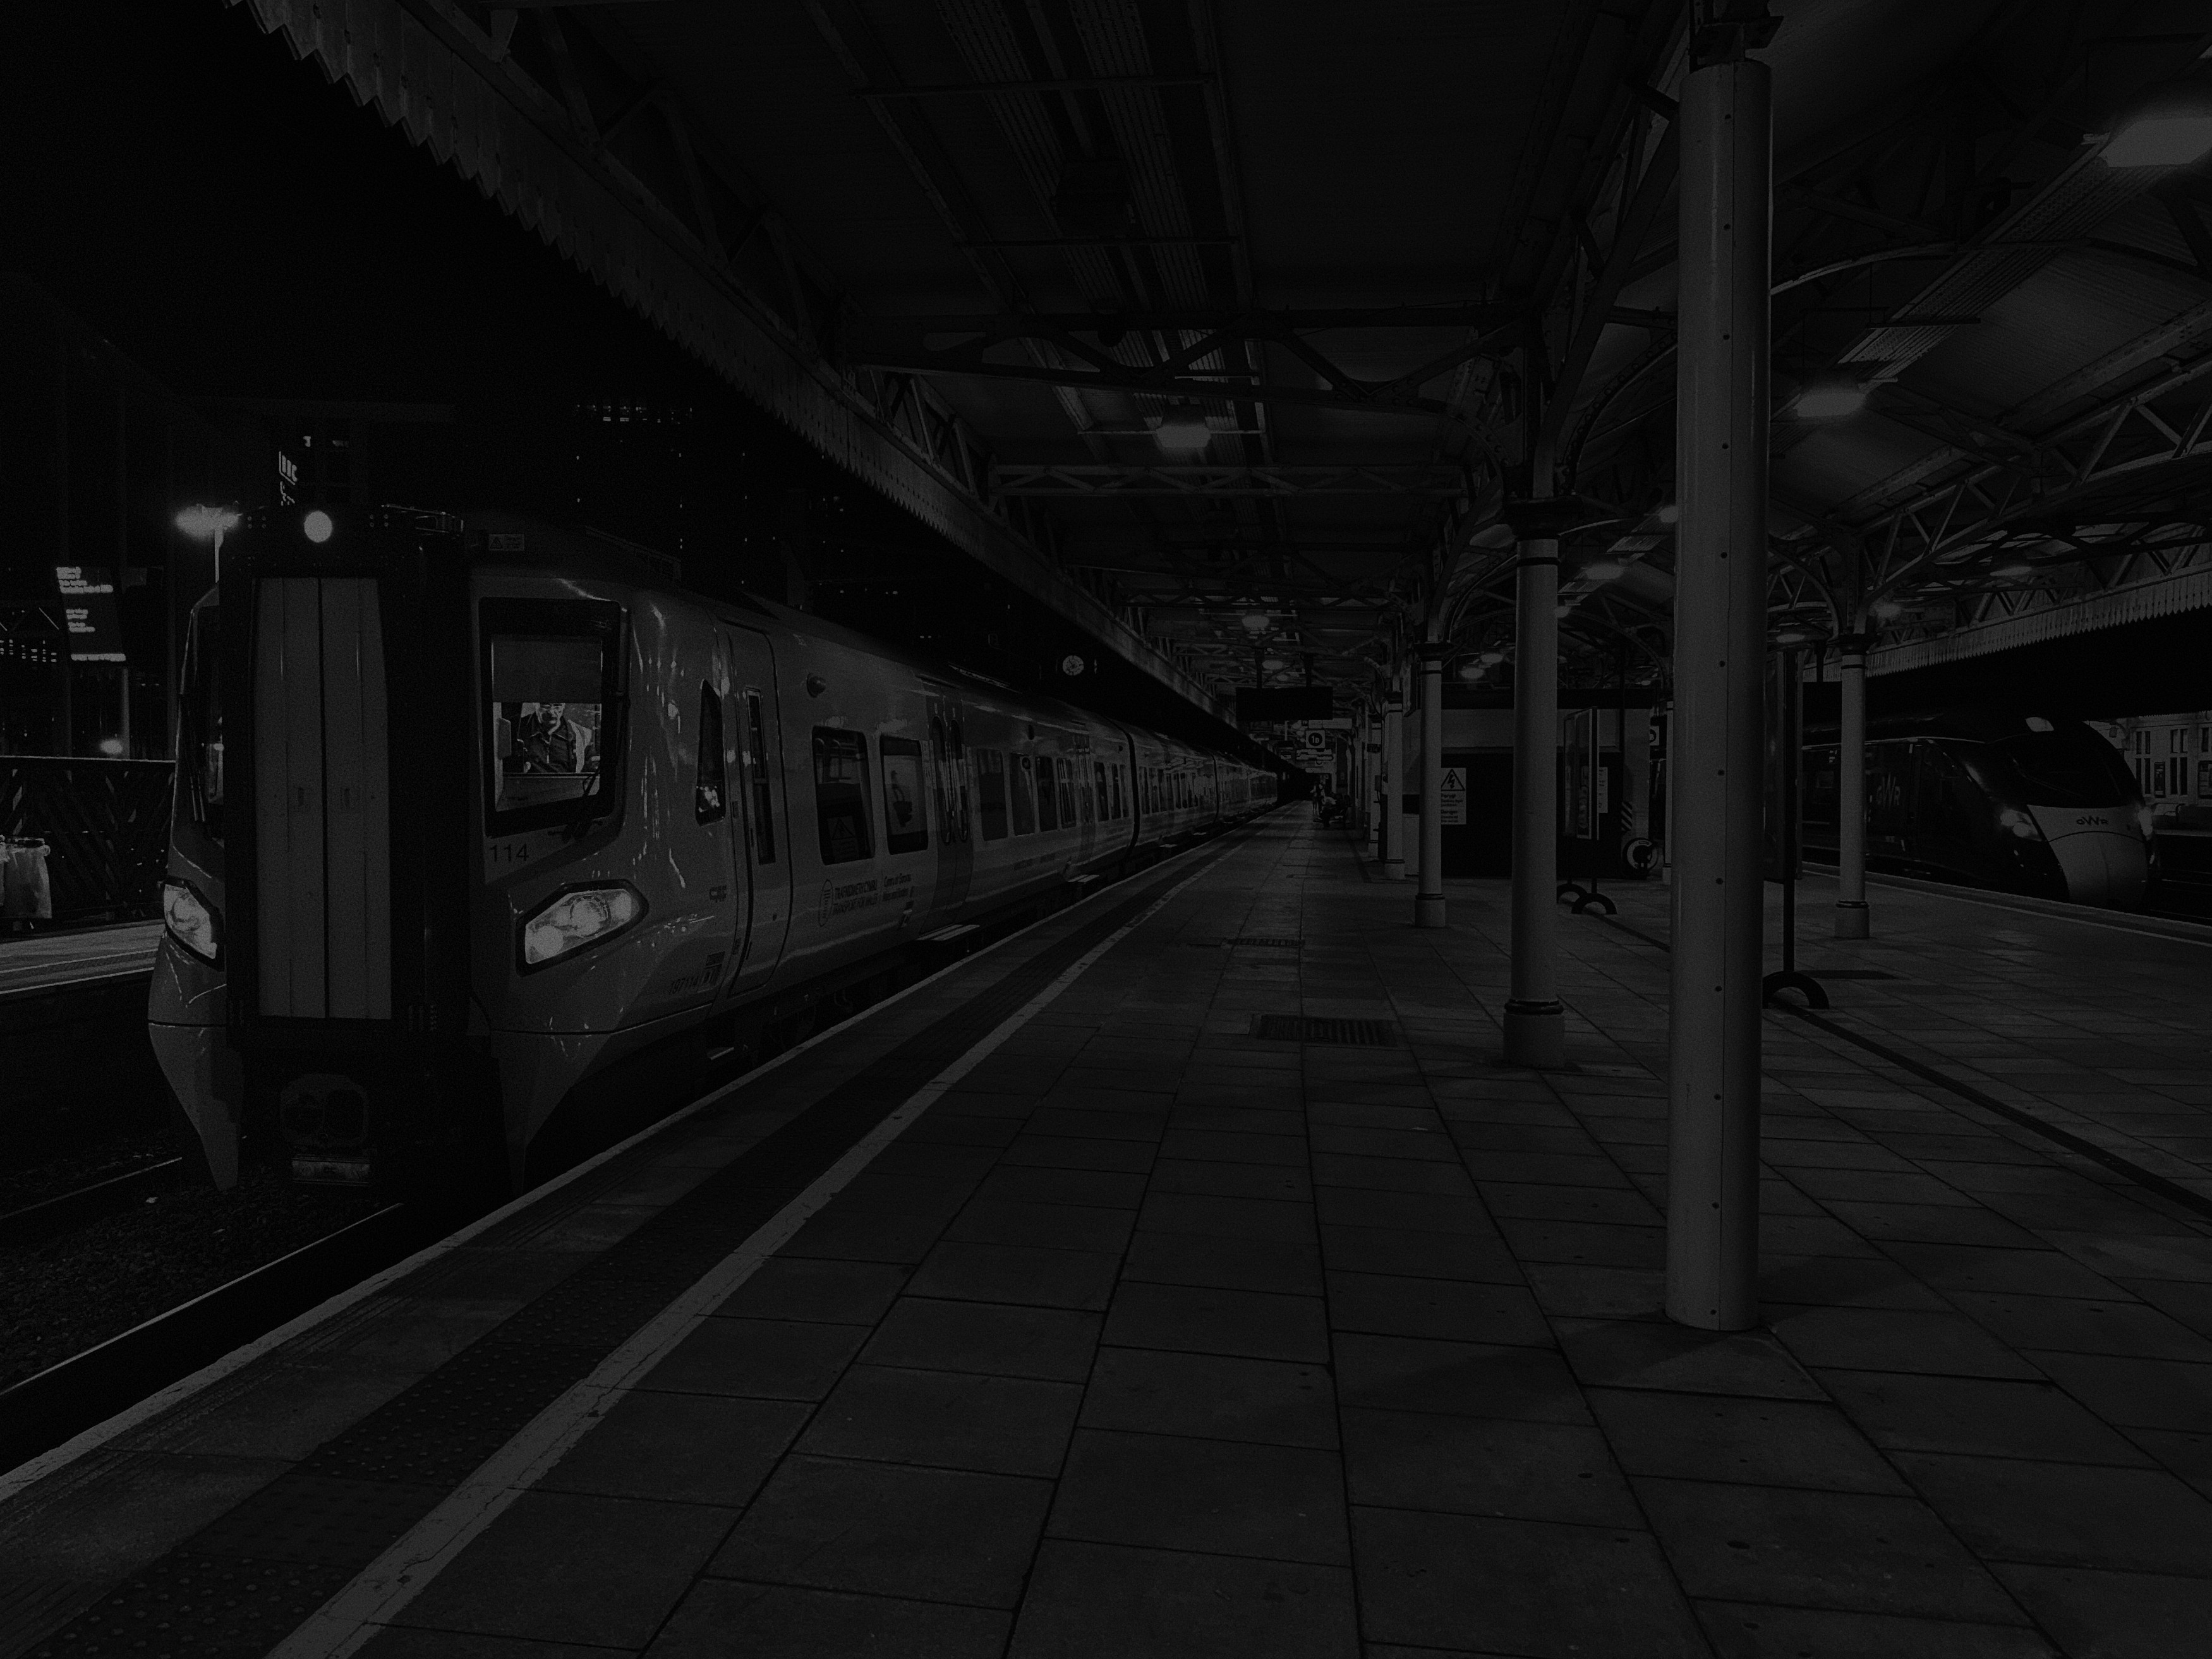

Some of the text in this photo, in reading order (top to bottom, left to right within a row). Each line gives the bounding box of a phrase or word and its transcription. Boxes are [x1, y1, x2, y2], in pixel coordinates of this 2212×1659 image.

[1875, 771, 1900, 811] GWR
[2076, 815, 2109, 826] GWR
[489, 842, 529, 862] 114
